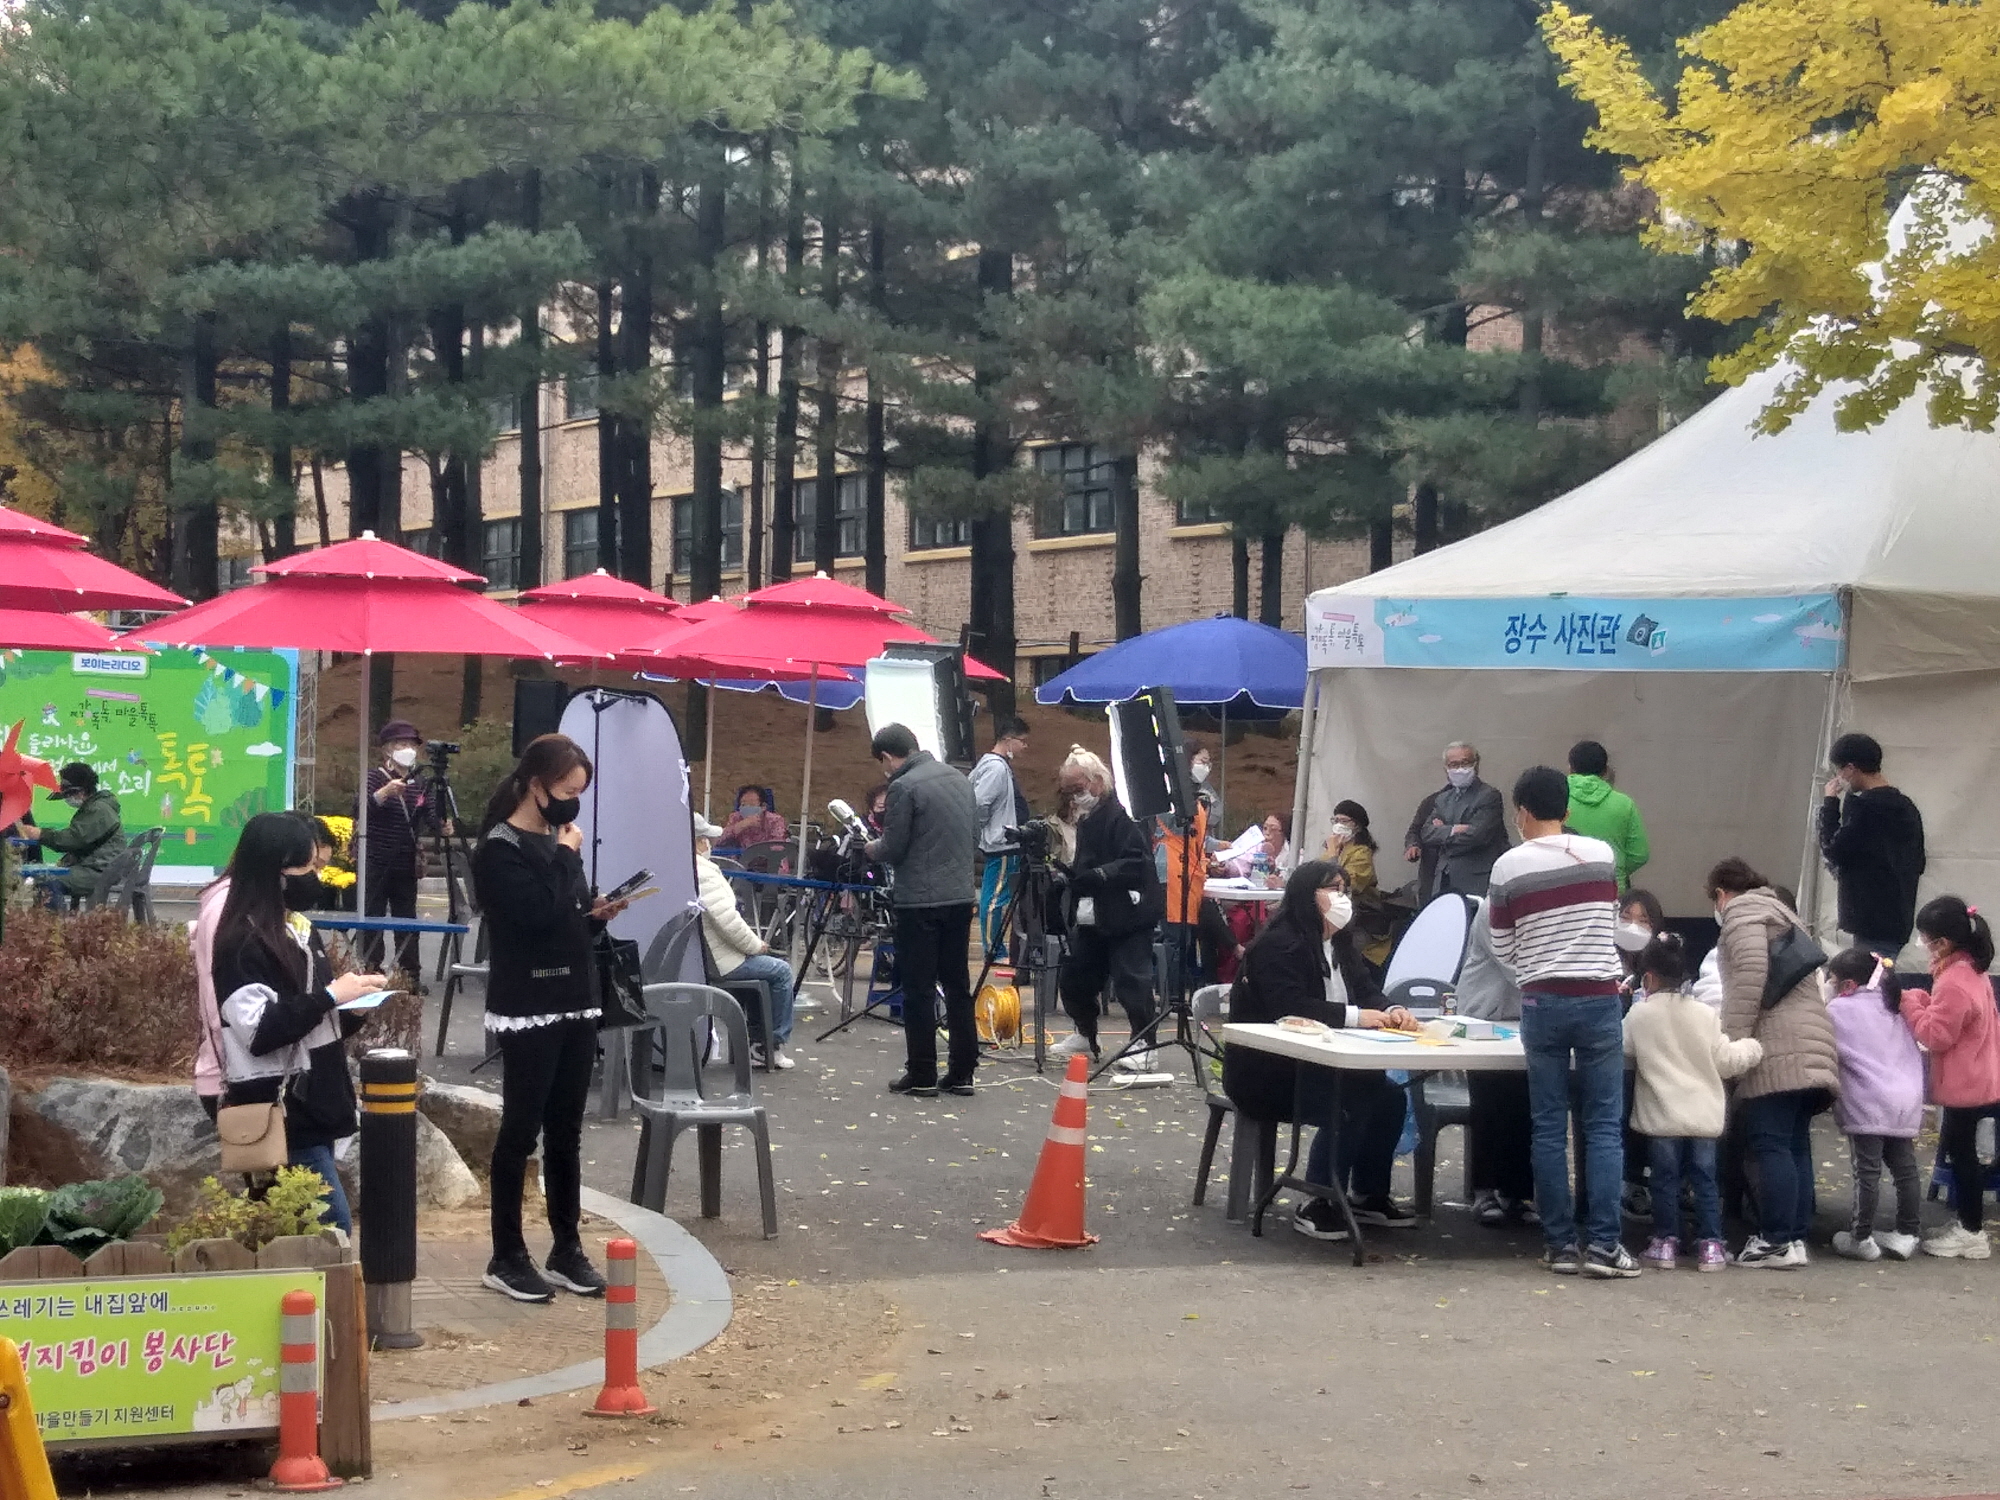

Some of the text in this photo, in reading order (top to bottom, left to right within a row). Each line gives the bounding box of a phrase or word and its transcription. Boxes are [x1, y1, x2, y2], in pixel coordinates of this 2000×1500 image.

[1504, 611, 1622, 655] 장수 사진관
[81, 657, 142, 671] 보이는라디오
[117, 769, 152, 797] 소리
[144, 1331, 236, 1373] 봉사단
[114, 1405, 174, 1424] 지원센터
